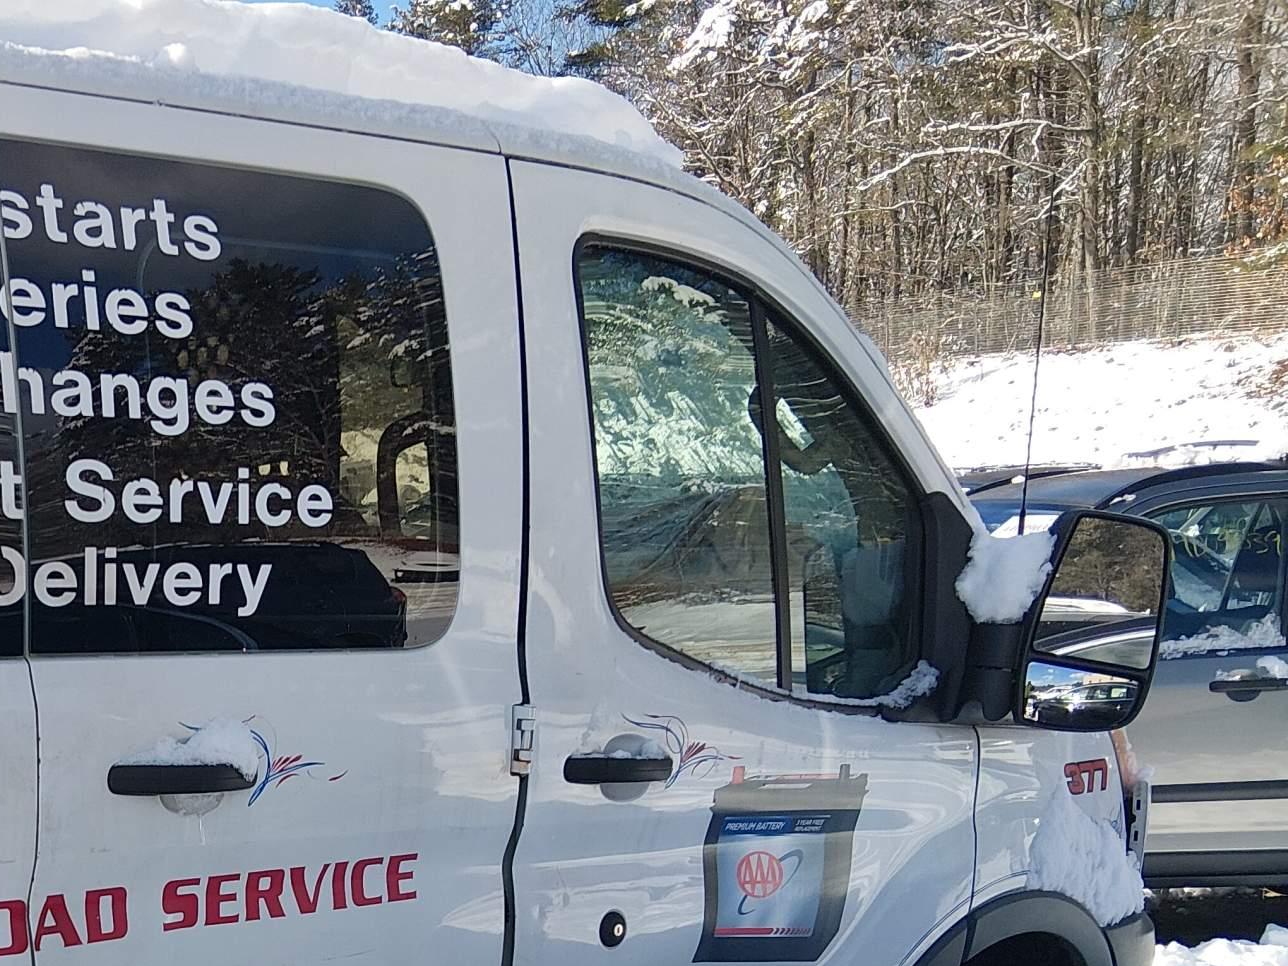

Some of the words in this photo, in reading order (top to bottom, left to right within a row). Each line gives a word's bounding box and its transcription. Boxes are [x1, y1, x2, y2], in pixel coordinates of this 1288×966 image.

[65, 458, 335, 529] Service
[1064, 758, 1108, 795] 377
[725, 822, 756, 831] PREMIUM
[756, 821, 786, 831] BATTERY
[739, 851, 781, 890] AAA
[162, 852, 418, 932] SERVICE
